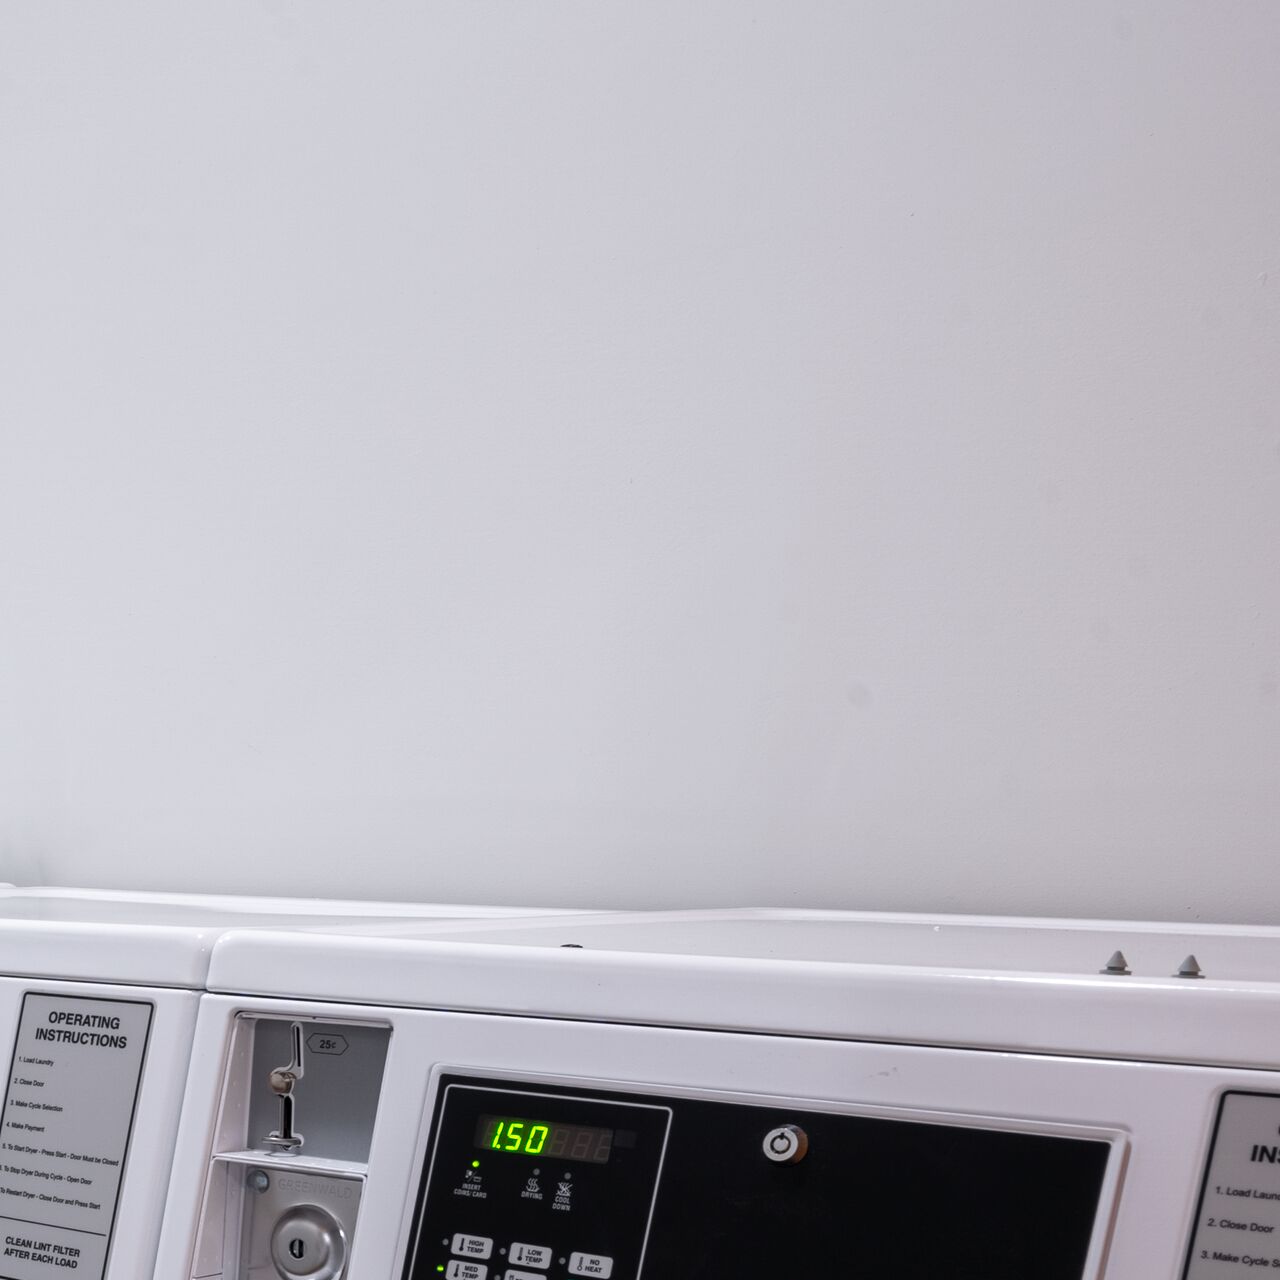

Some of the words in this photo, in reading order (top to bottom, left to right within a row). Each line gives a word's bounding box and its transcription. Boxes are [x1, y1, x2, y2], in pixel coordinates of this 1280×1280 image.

[48, 1011, 120, 1030] OPERATING
[35, 1028, 127, 1049] INSTRUCTIONS
[36, 1058, 54, 1067] Laundry
[19, 1078, 32, 1086] Close
[15, 1100, 28, 1108] Make
[28, 1101, 41, 1110] Cycle
[42, 1103, 63, 1112] Selection
[11, 1122, 23, 1130] Make
[24, 1123, 45, 1132] Payment
[492, 1121, 549, 1153] 1.50
[14, 1144, 25, 1152] Start
[25, 1146, 38, 1155] Dryer
[41, 1149, 55, 1157] Press
[55, 1151, 67, 1159] Start
[70, 1153, 82, 1161] Door
[82, 1155, 95, 1163] Must
[102, 1158, 119, 1167] Closed
[10, 1166, 20, 1175] Stop
[21, 1168, 34, 1177] Dryer
[34, 1170, 50, 1180] During
[50, 1173, 63, 1181] Cycle
[66, 1176, 79, 1184] Open
[278, 1178, 353, 1199] GREENWALD
[462, 1183, 481, 1191] INSERT
[1216, 1185, 1223, 1195] 1.
[1226, 1187, 1252, 1198] Load
[6, 1188, 23, 1197] Restart
[23, 1190, 36, 1199] Dryer
[39, 1193, 52, 1202] Close
[53, 1195, 65, 1204] Door
[65, 1198, 74, 1206] and
[74, 1199, 88, 1208] Press
[88, 1202, 101, 1210] Start
[521, 1191, 543, 1200] DRYING
[555, 1196, 570, 1204] COOL
[552, 1203, 571, 1211] DOWN
[1207, 1217, 1216, 1227] 2.
[1219, 1219, 1247, 1231] Close
[1250, 1222, 1274, 1233] Door
[5, 1236, 33, 1248] CLEAN
[33, 1241, 52, 1252] LINT
[52, 1244, 81, 1258] FILTER
[468, 1239, 484, 1247] HIGH
[467, 1246, 484, 1254] TEMP
[527, 1249, 542, 1257] LOW
[4, 1248, 30, 1260] AFTER
[31, 1253, 54, 1264] EACH
[55, 1257, 78, 1269] LOAD
[525, 1256, 543, 1264] TEMP
[1201, 1250, 1209, 1260] 3.
[1212, 1252, 1240, 1263] Make
[1241, 1255, 1270, 1267] Cycle
[464, 1265, 479, 1273] MED
[585, 1265, 602, 1274] HEAT
[461, 1272, 479, 1280] TEMP
